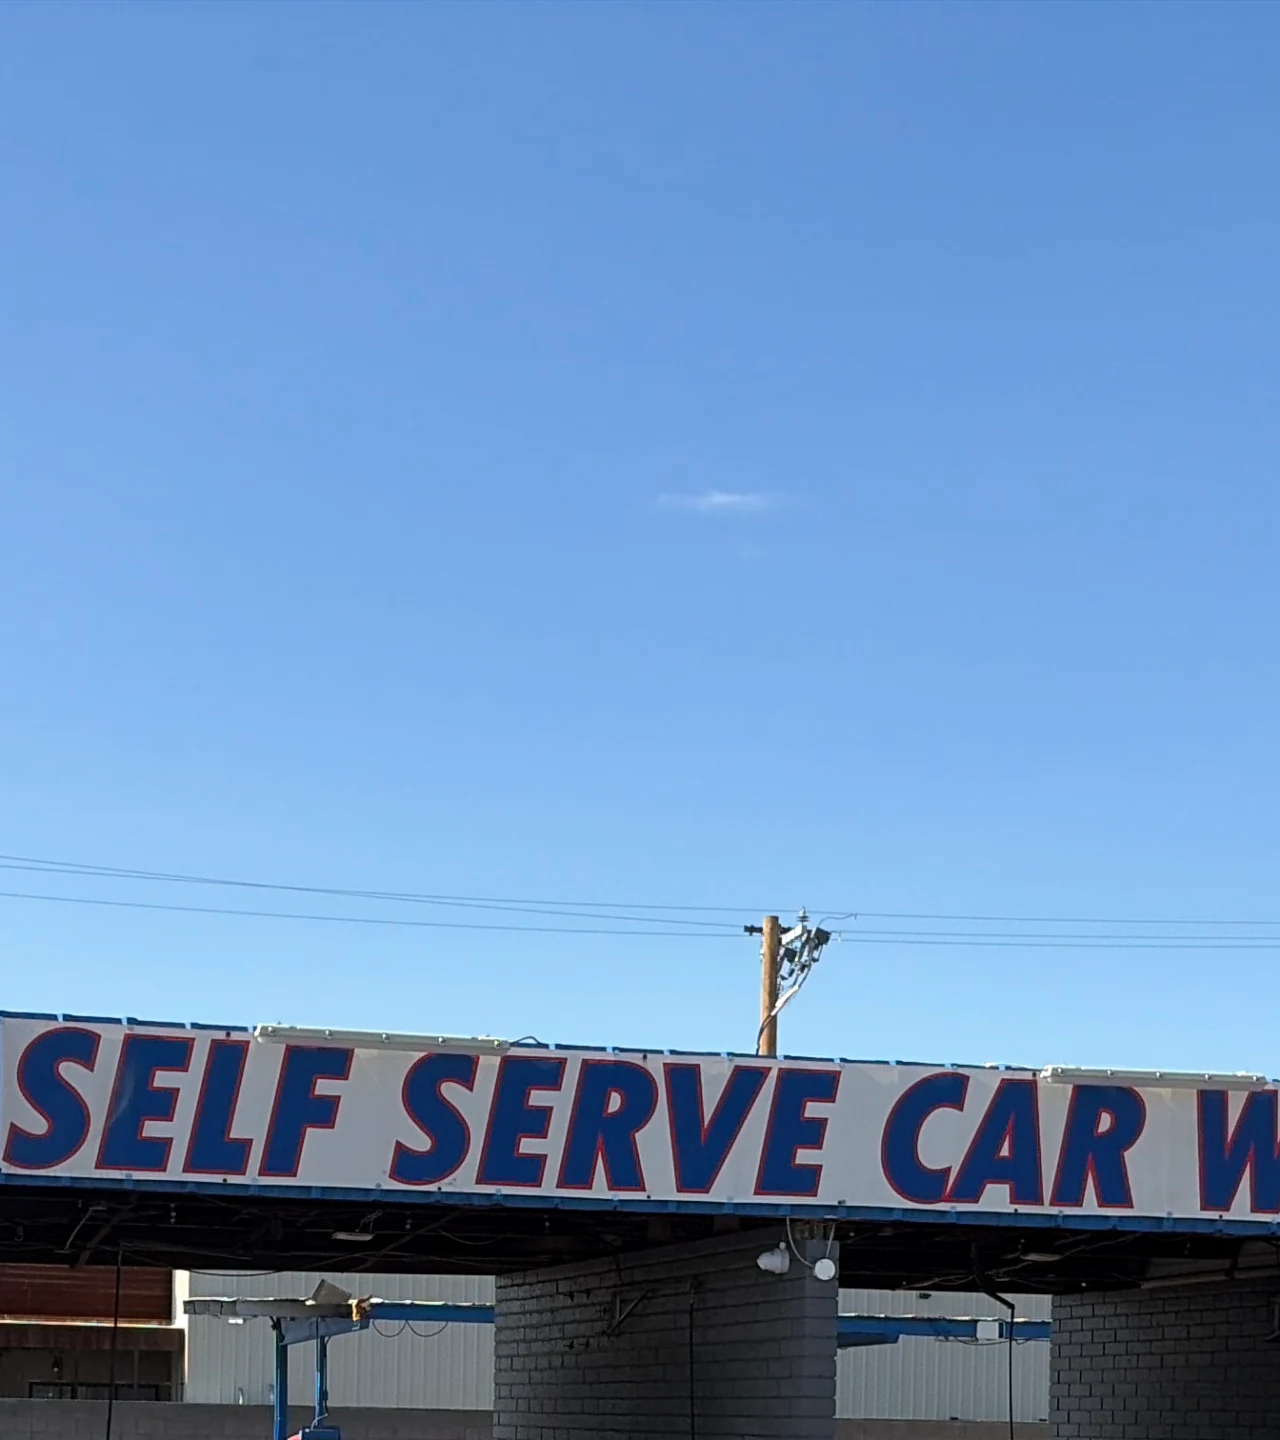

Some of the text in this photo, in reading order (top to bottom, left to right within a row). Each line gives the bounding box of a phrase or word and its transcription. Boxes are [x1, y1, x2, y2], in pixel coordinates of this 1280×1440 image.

[2, 1026, 355, 1177] SELF
[388, 1052, 842, 1197] SERVE
[881, 1070, 1146, 1210] CAR
